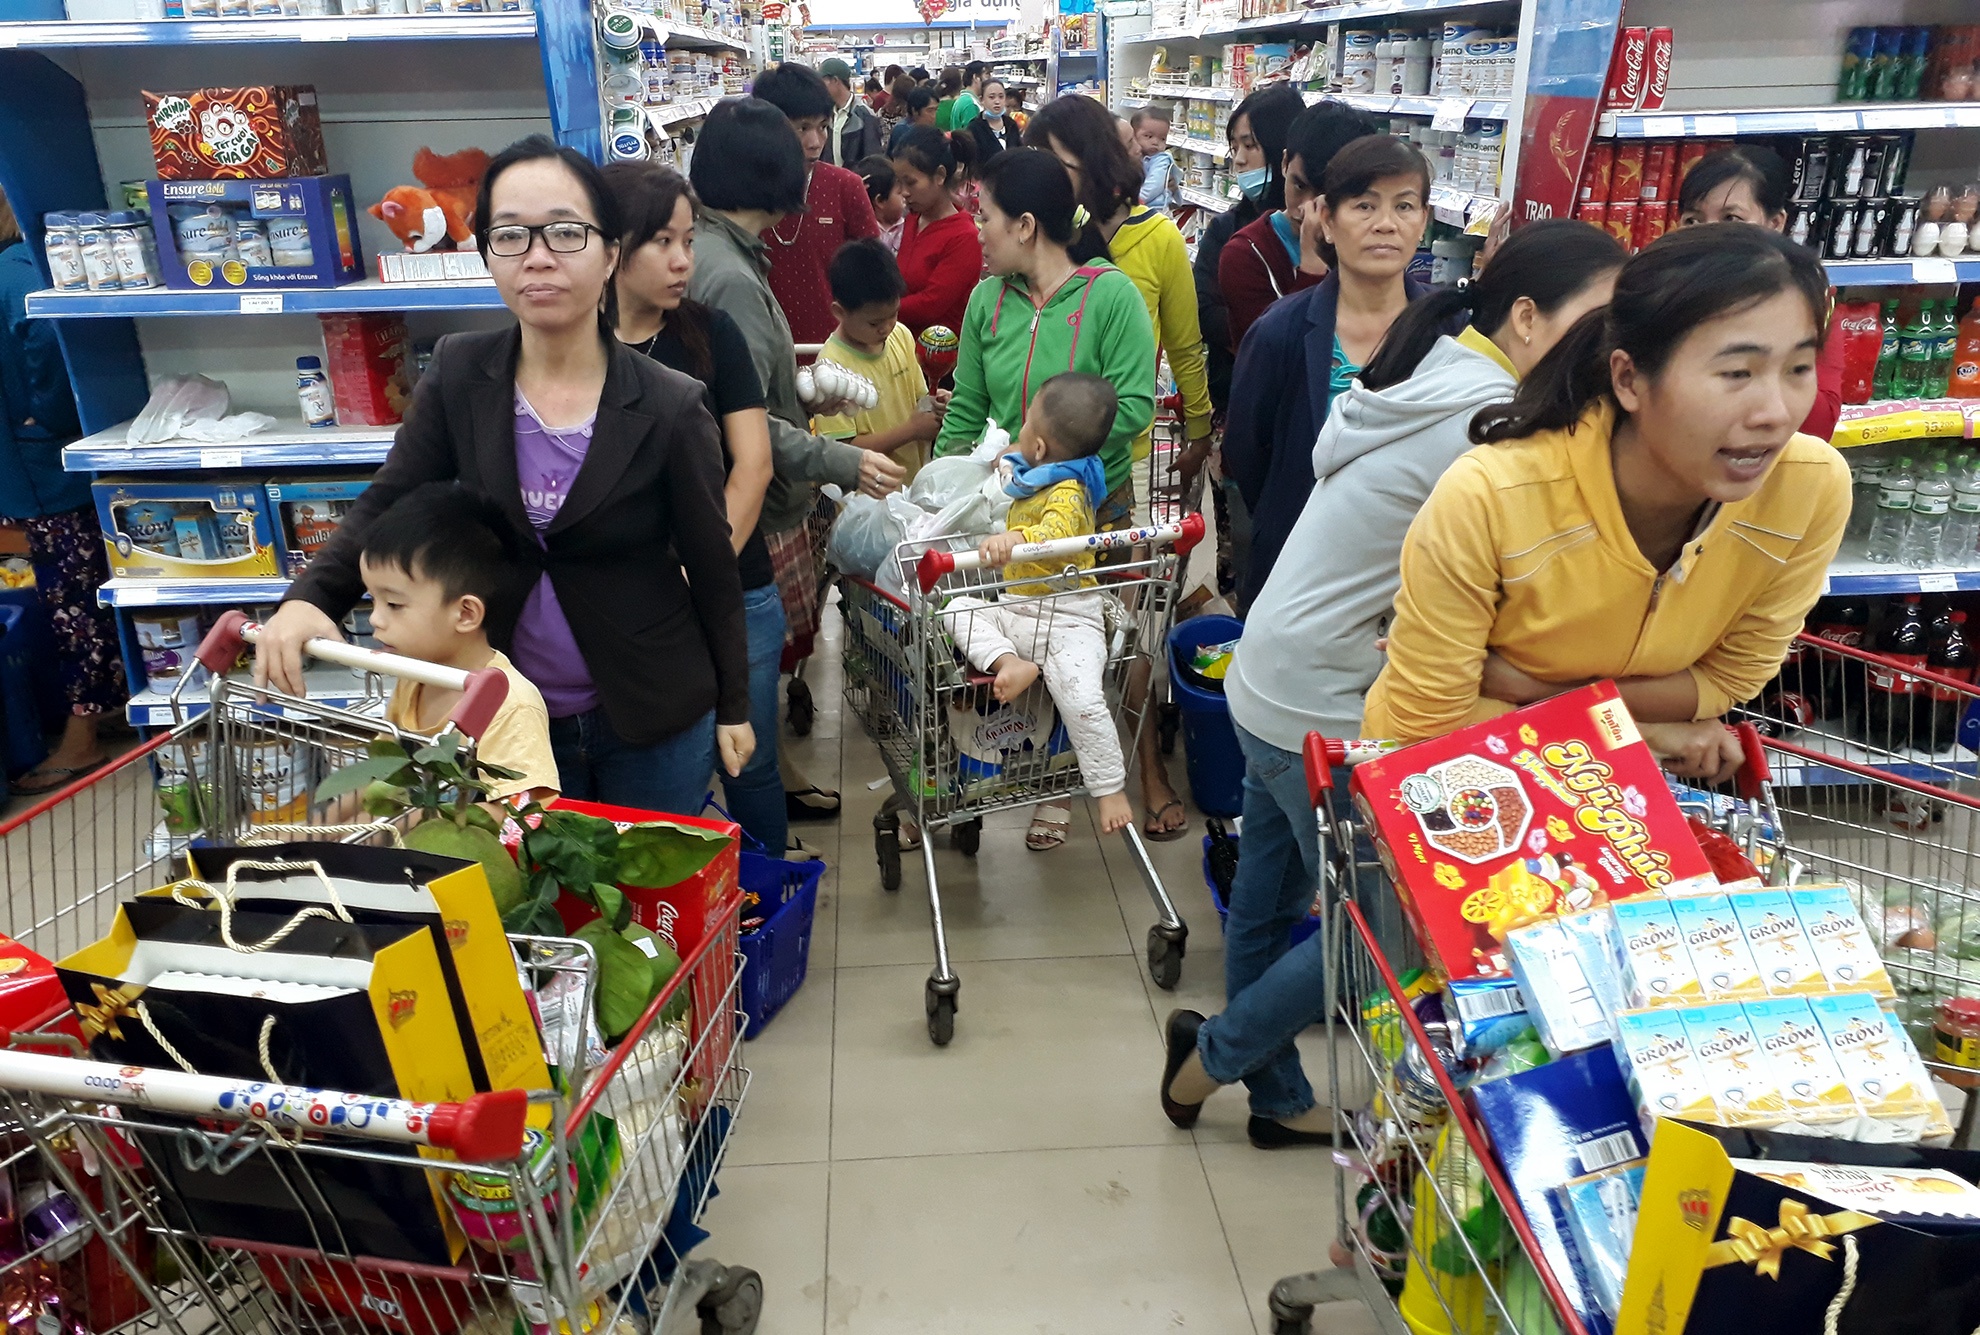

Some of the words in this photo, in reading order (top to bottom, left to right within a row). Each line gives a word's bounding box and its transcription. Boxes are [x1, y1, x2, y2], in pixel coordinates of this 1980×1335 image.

[153, 99, 191, 127] MIRINDA
[241, 133, 260, 158] GA!
[1792, 158, 1802, 185] zero
[163, 183, 206, 196] Ensure
[206, 182, 227, 196] Gold
[253, 273, 269, 282] Sống
[297, 273, 318, 281] Ensure
[1542, 741, 1624, 811] Ngũ
[1576, 805, 1673, 889] Phúc
[1597, 857, 1626, 885] Quality
[1629, 926, 1676, 951] GROW
[1689, 921, 1736, 945] GROW
[1749, 917, 1796, 940] GROW
[1810, 915, 1856, 937] GROW
[1699, 1030, 1751, 1058] GROW
[1765, 1025, 1816, 1051] GROW
[1834, 1021, 1885, 1047] GROW
[1635, 1036, 1686, 1065] GROW
